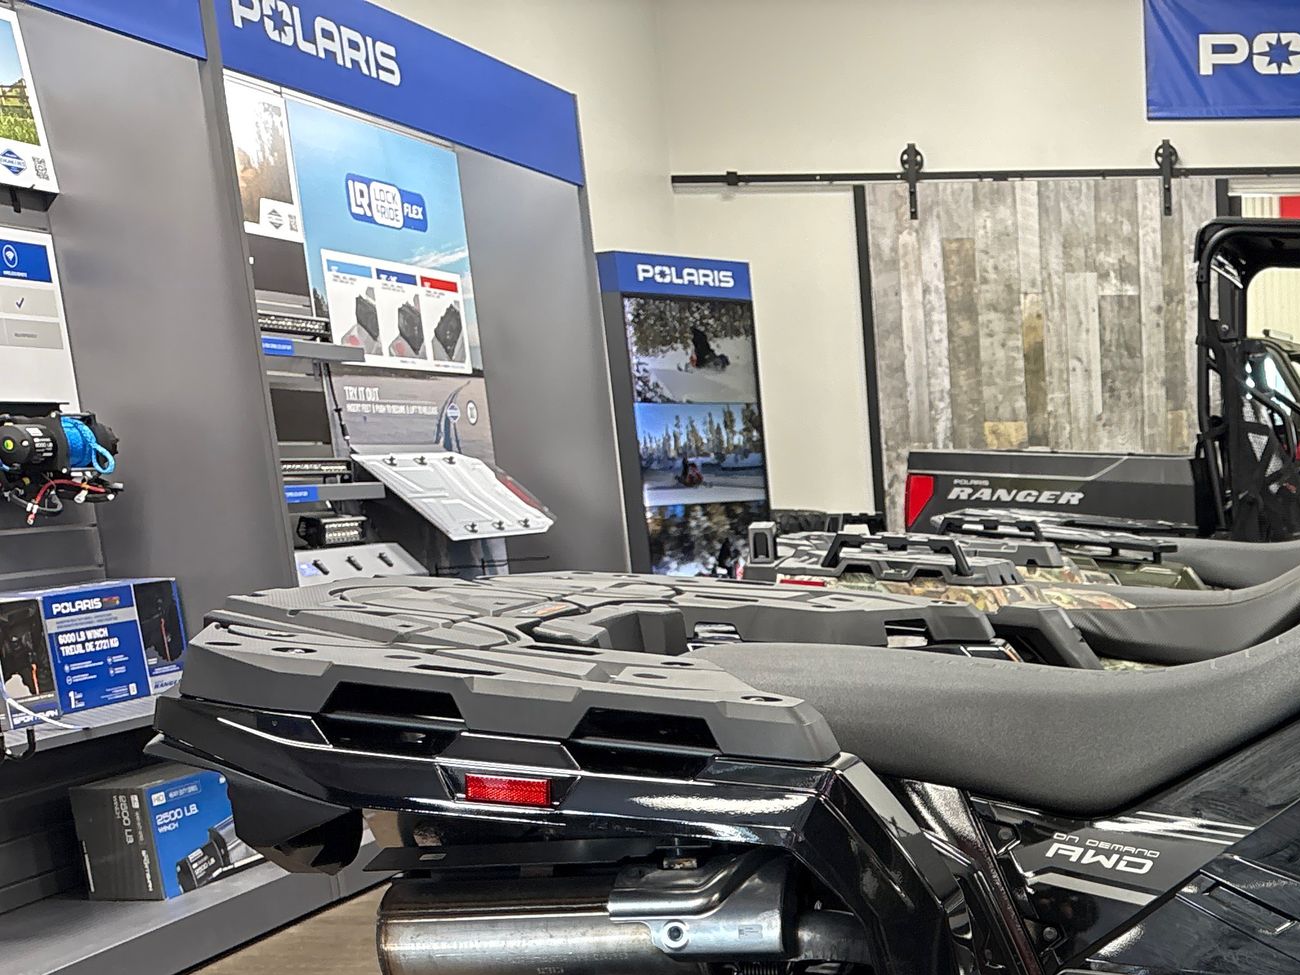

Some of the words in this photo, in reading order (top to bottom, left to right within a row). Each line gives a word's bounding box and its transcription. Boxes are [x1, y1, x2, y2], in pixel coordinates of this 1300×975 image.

[231, 0, 402, 87] POLARIS
[403, 202, 424, 220] FLEX
[636, 264, 735, 288] POLARIS
[953, 478, 990, 486] POLARIS
[947, 487, 1085, 505] RANGER
[52, 598, 102, 615] POLARIS
[76, 630, 86, 642] LB
[86, 627, 108, 640] WINCH
[85, 641, 95, 652] DE
[118, 795, 131, 827] 2500
[156, 808, 183, 826] 2500
[158, 822, 179, 833] WINCH
[1053, 832, 1079, 843] ON
[1085, 839, 1160, 858] DEMAND
[1045, 842, 1153, 874] AWD
